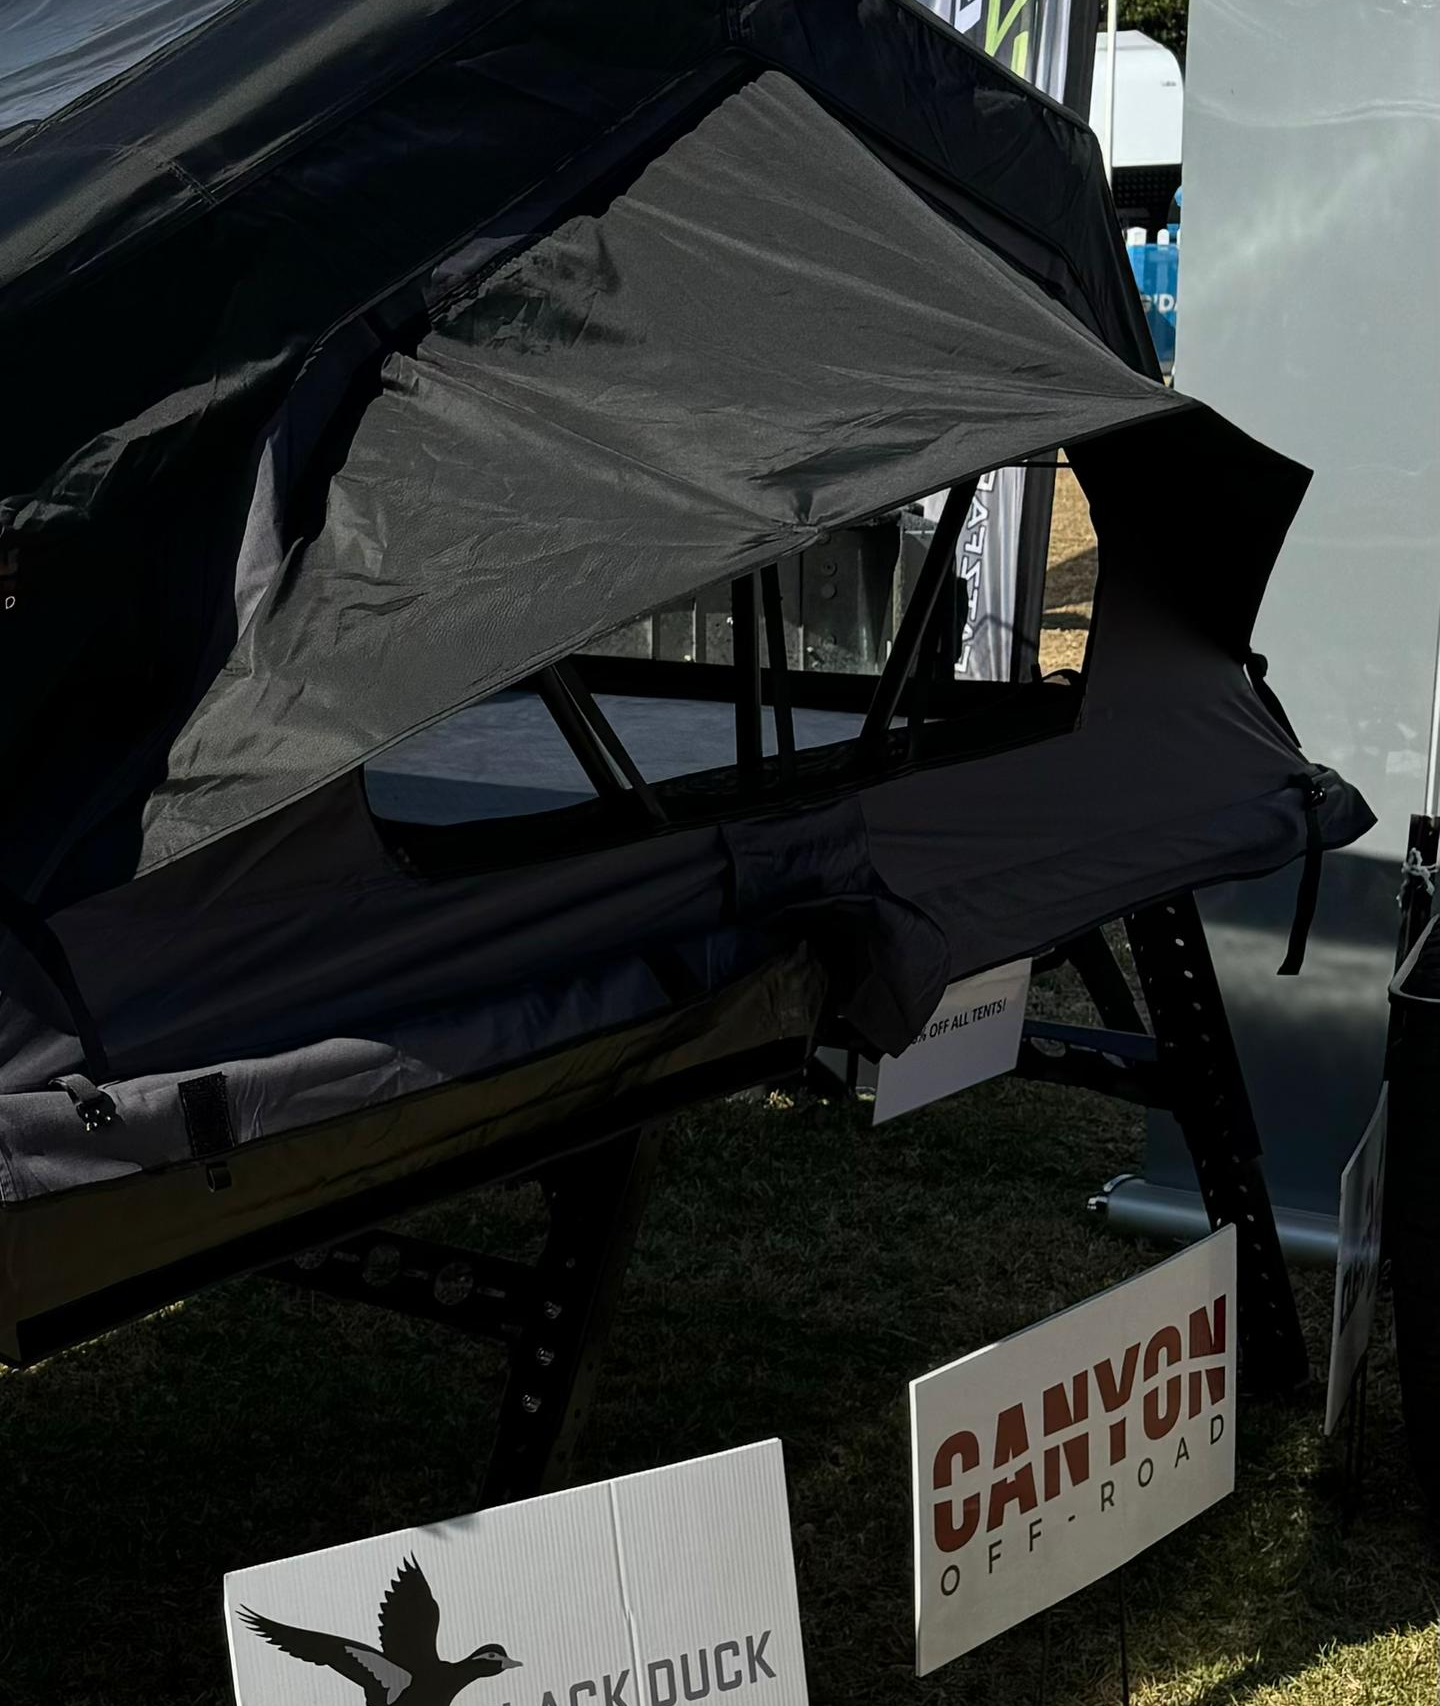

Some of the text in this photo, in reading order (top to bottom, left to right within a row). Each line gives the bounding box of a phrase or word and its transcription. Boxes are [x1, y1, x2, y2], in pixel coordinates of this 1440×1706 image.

[929, 1019, 950, 1038] OFF
[950, 1012, 969, 1031] ALL
[972, 997, 1007, 1023] TENTS!
[933, 1294, 1227, 1553] CANYON
[940, 1414, 1225, 1596] OFF-ROAD
